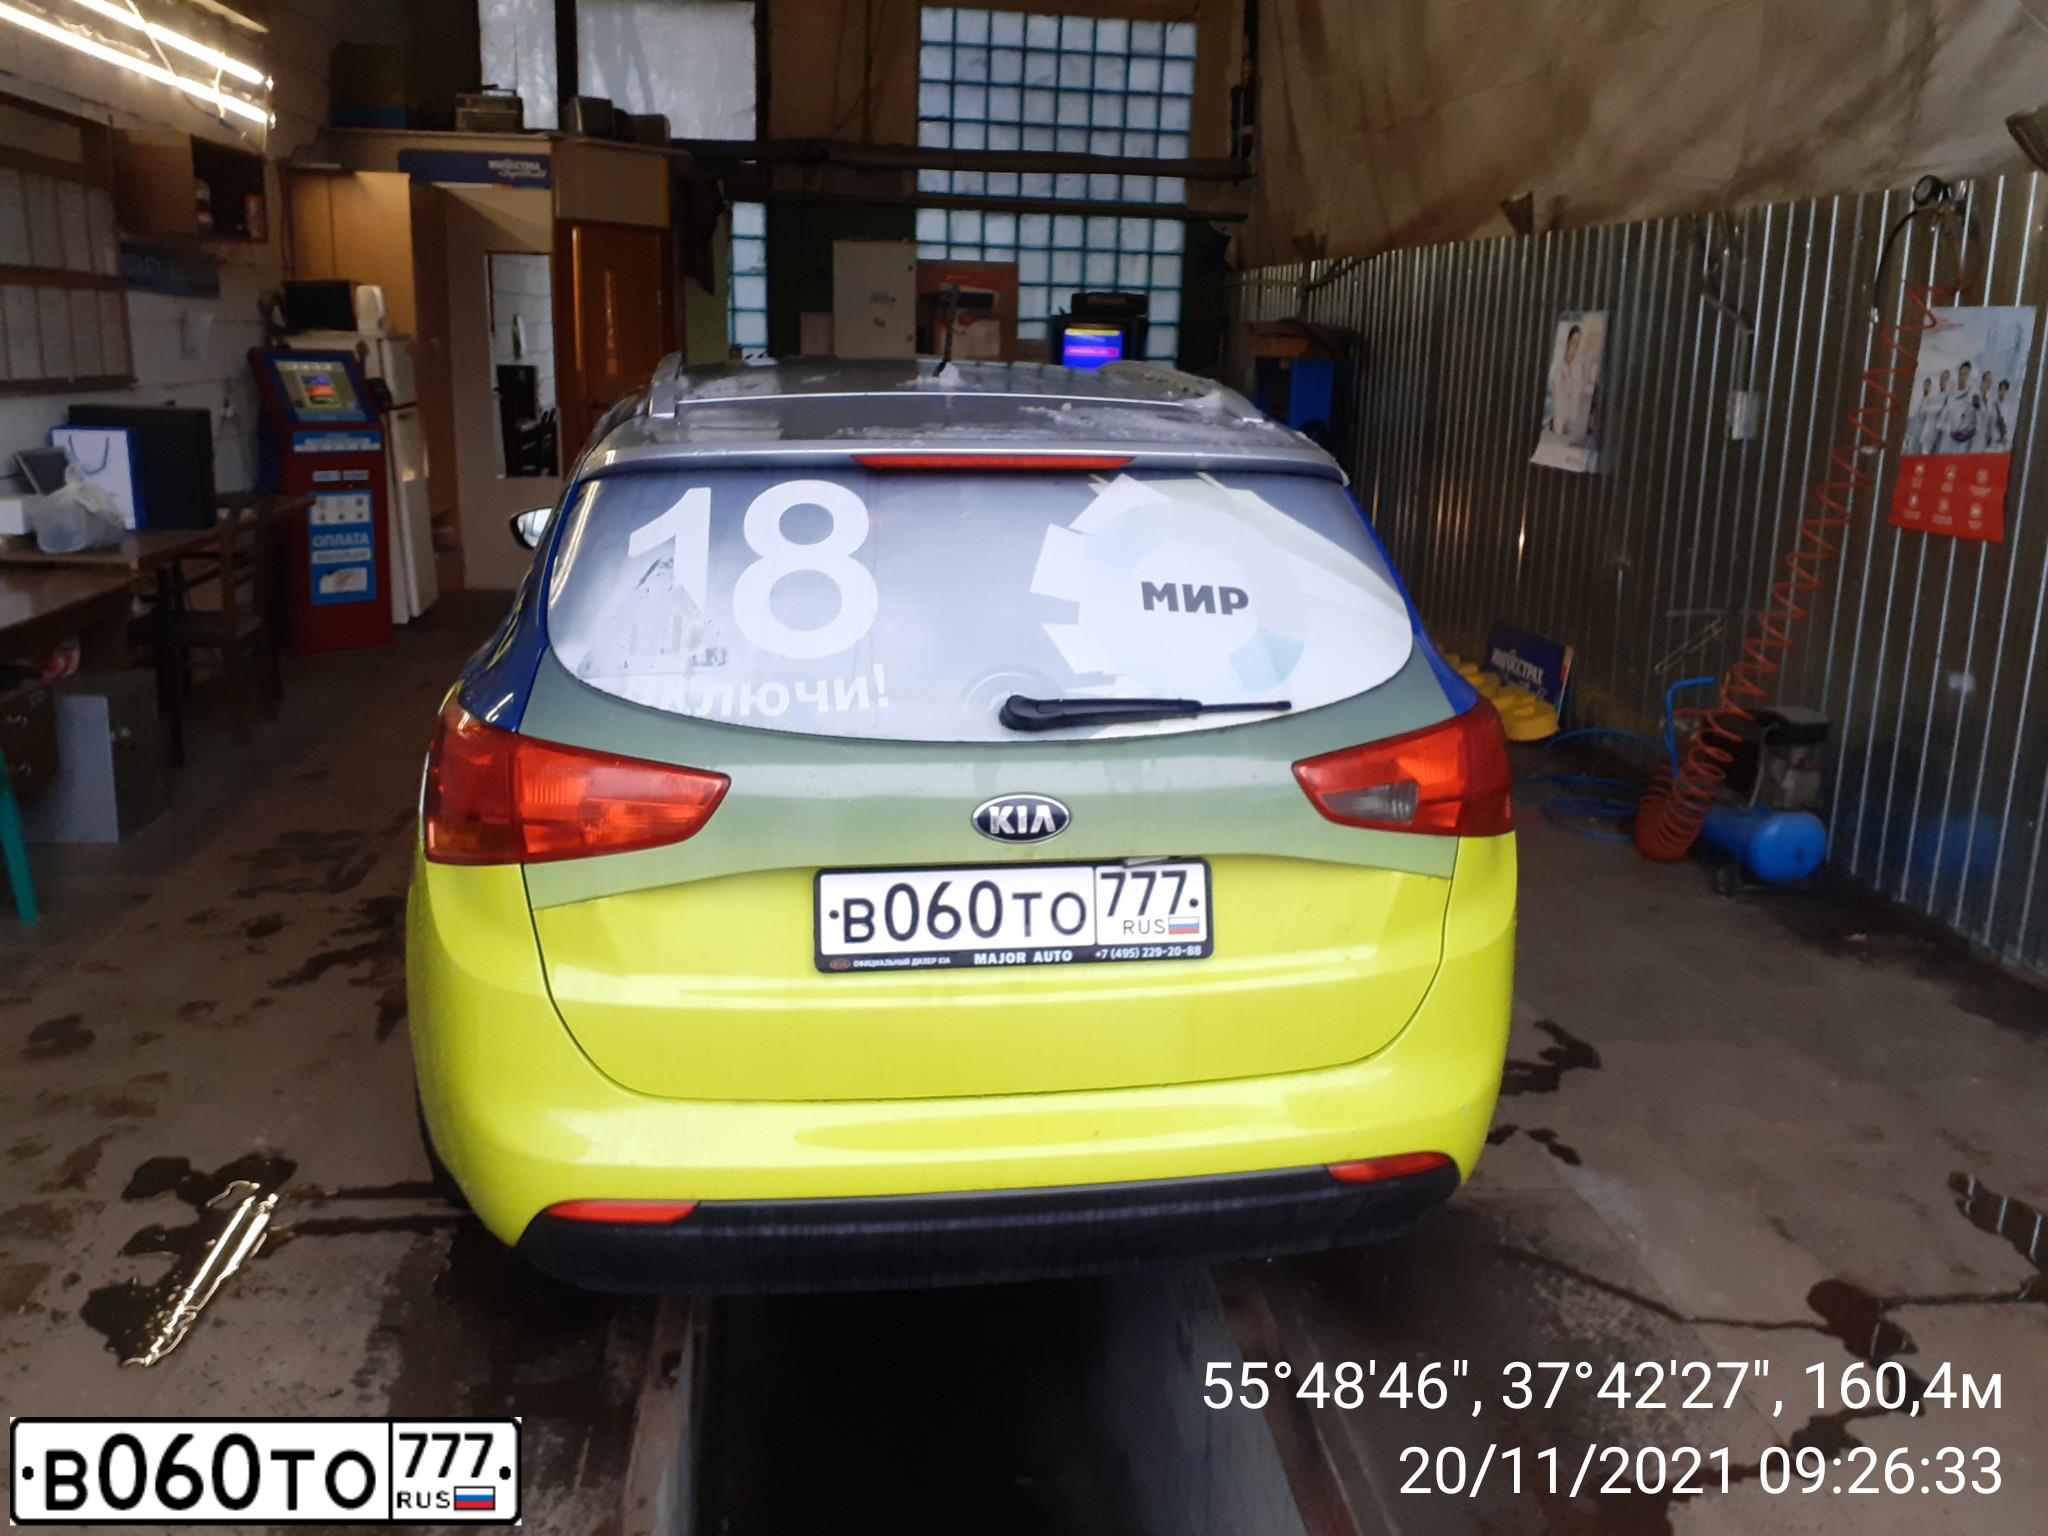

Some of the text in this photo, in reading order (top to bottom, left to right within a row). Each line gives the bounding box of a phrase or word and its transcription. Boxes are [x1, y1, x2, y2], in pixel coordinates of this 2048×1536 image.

[313, 533, 370, 548] ОПЛАТА
[628, 479, 879, 659] 18
[1141, 581, 1249, 616] МИР
[989, 805, 1056, 834] KIA
[1100, 870, 1187, 917] 777
[1122, 919, 1166, 935] RUS
[973, 950, 1073, 965] MAJOR AUTO
[1095, 949, 1108, 960] +7
[1110, 947, 1140, 960] (495)
